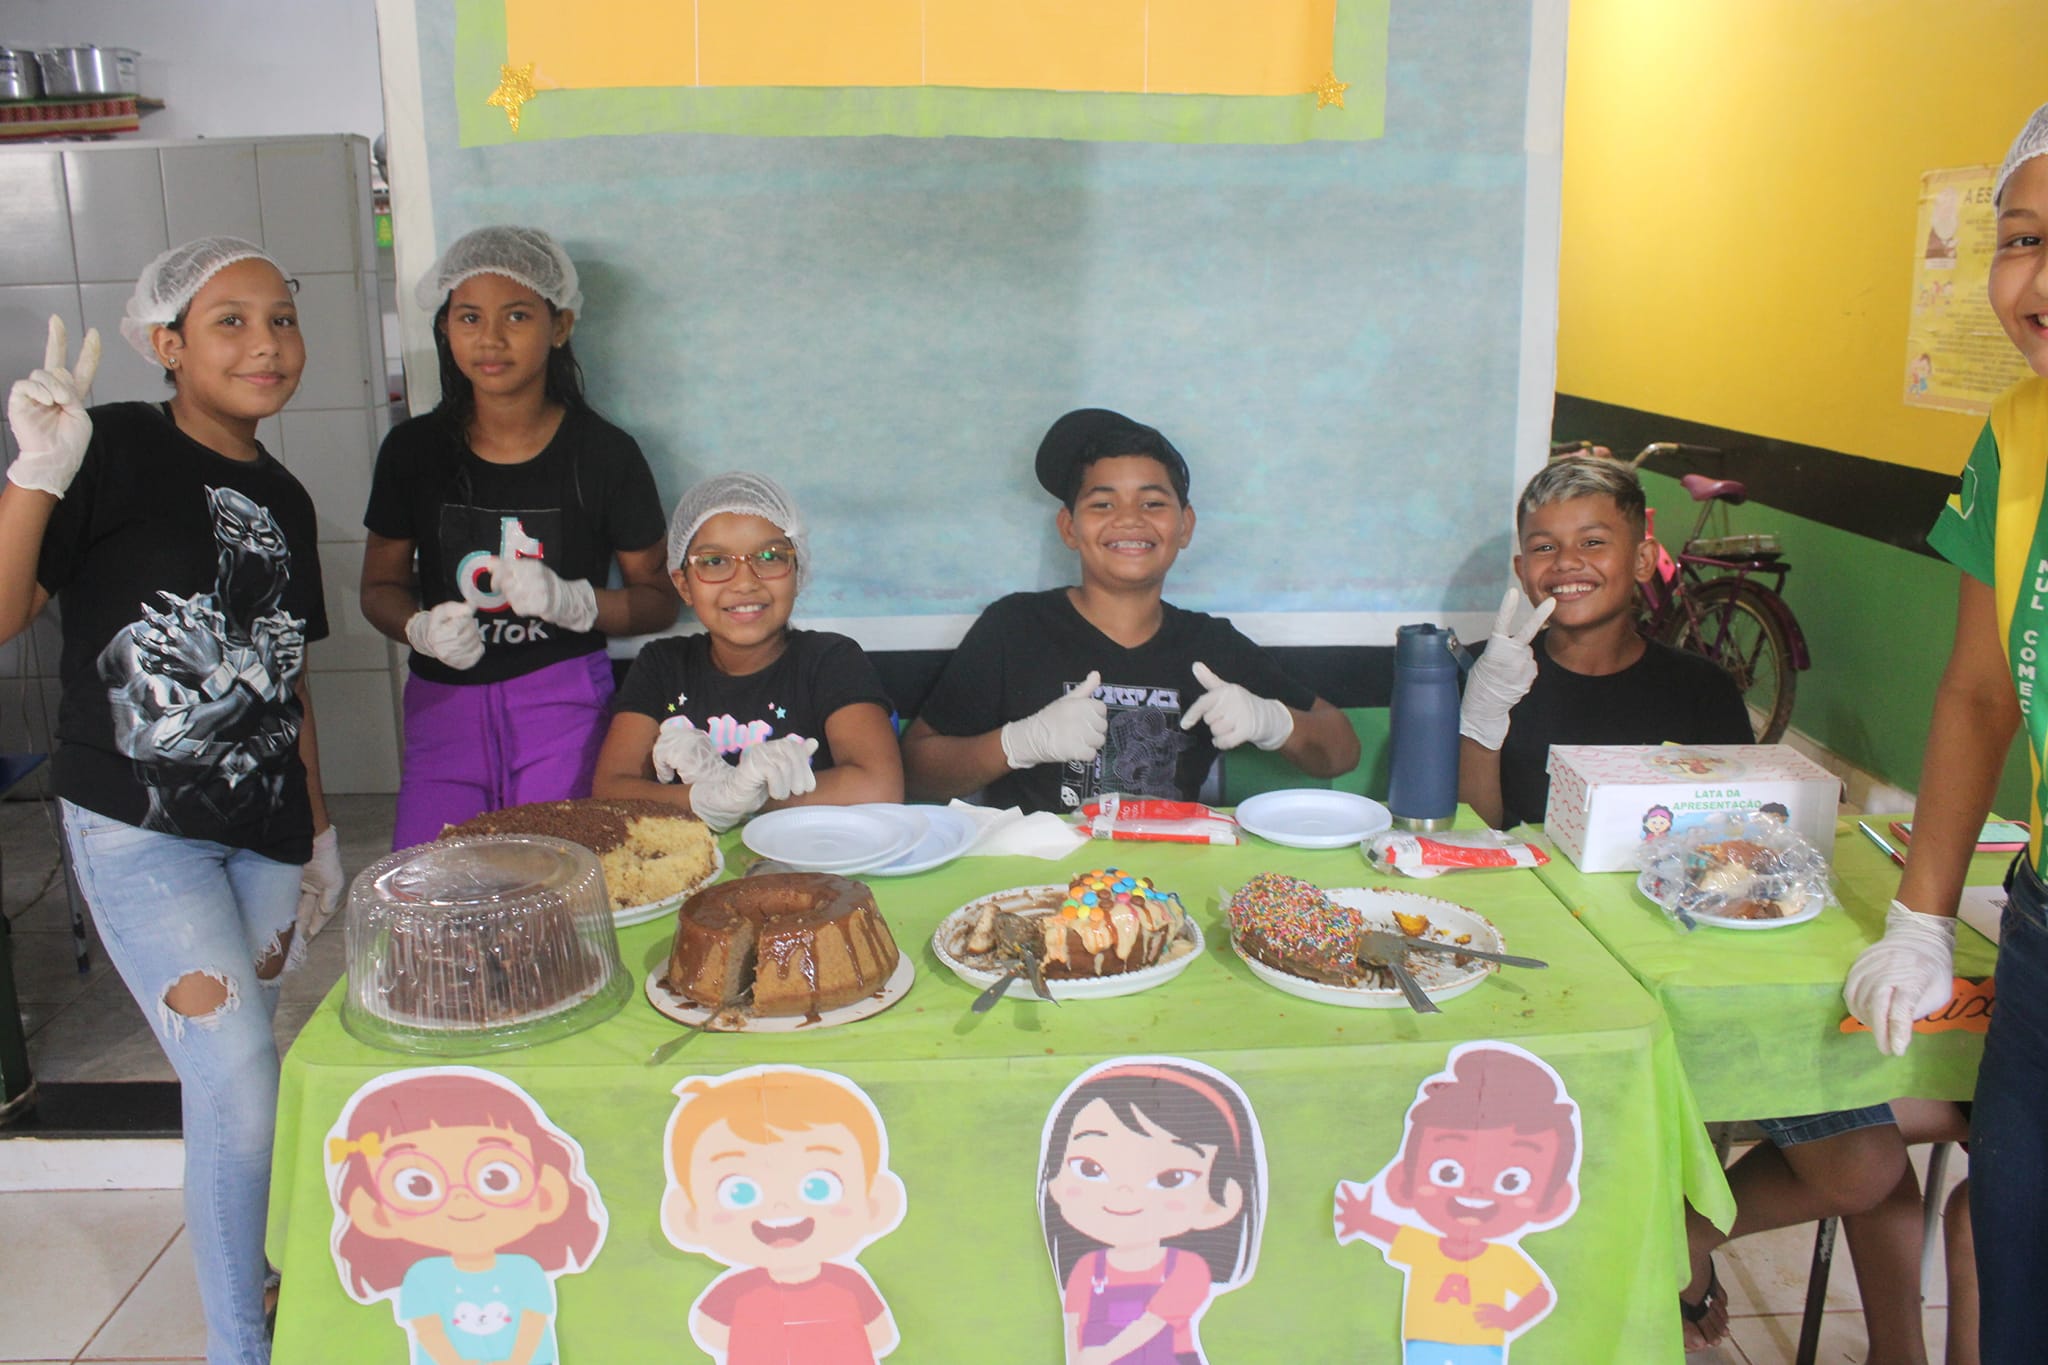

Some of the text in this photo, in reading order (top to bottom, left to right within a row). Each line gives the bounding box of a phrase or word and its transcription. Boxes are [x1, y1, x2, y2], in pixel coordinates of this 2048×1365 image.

[1695, 789, 1741, 799] LATA DA
[1673, 799, 1762, 810] APRESENTAÇÃO
[1434, 1273, 1472, 1305] A
